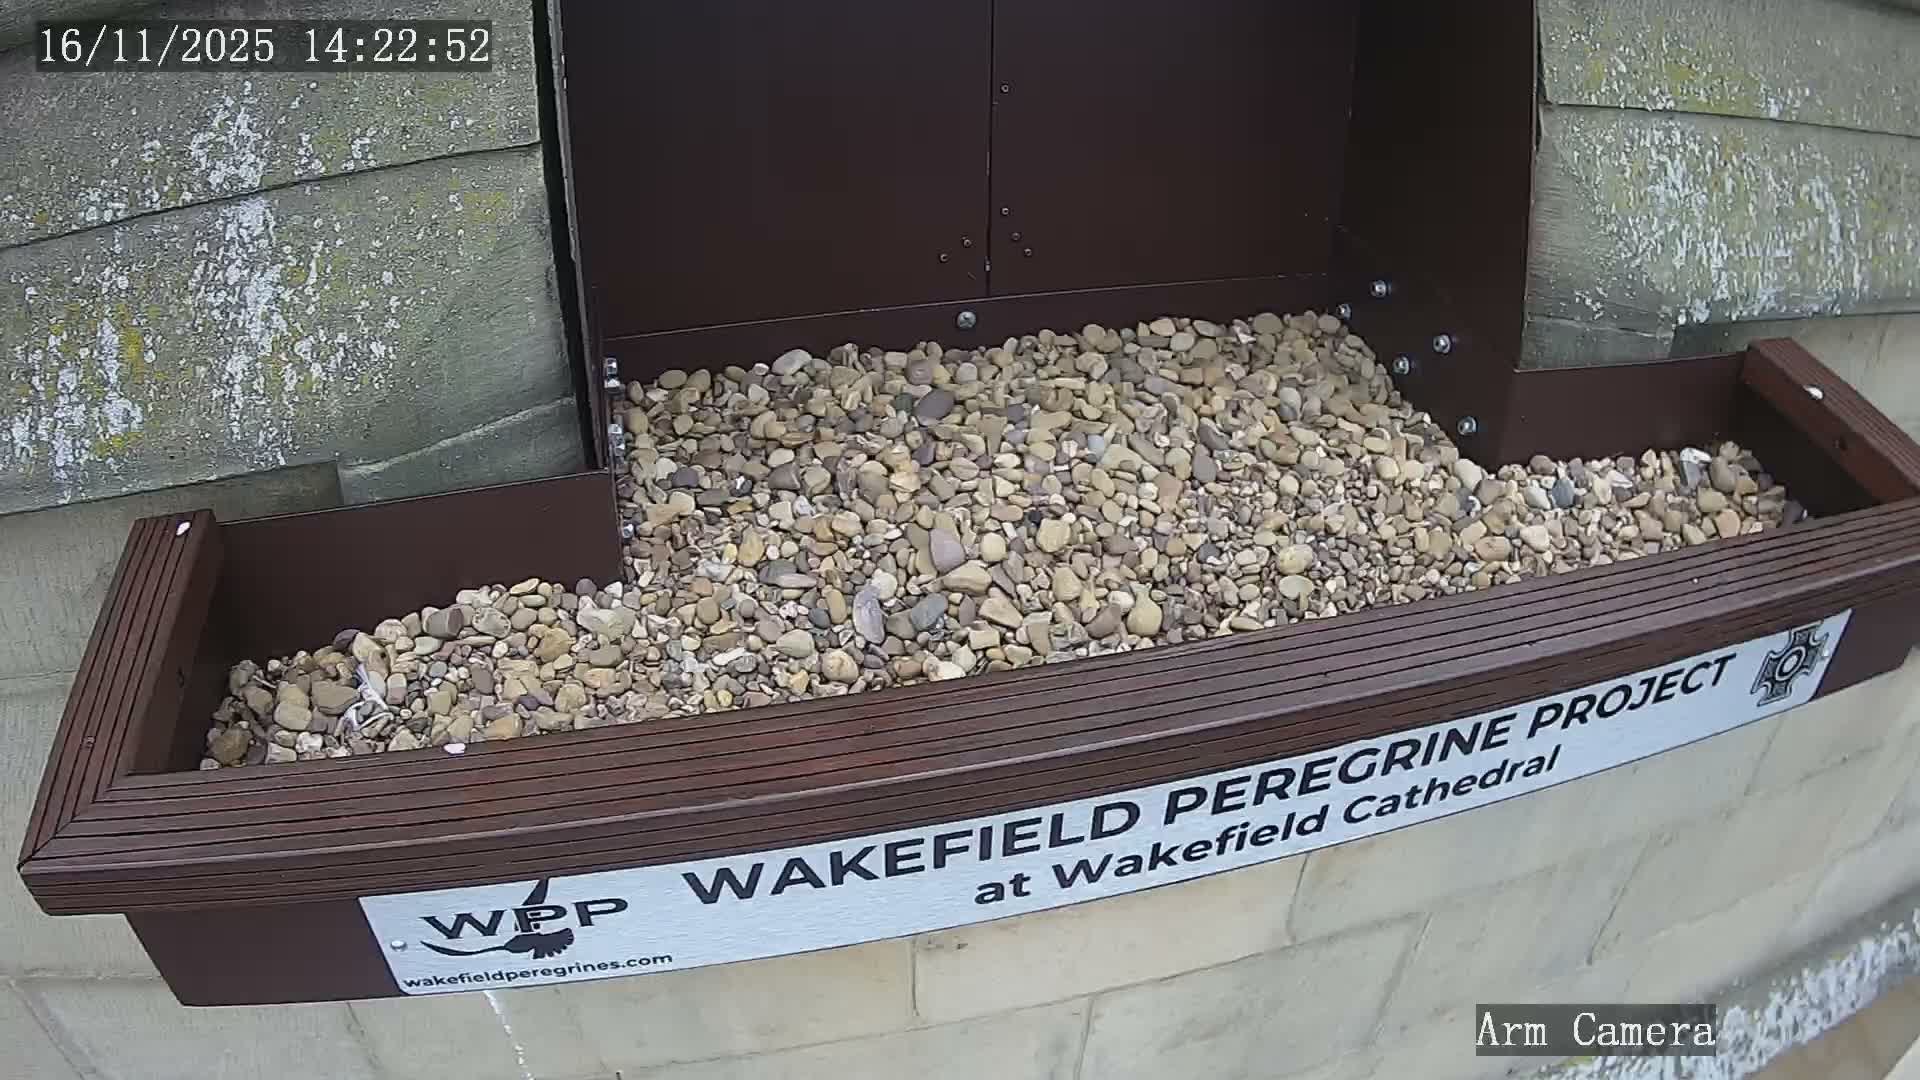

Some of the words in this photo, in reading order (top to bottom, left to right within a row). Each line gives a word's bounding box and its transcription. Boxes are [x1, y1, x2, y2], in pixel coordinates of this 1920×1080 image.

[682, 800, 1141, 905] WAKEFIELD
[1164, 713, 1518, 825] PEREGRINE
[1527, 652, 1737, 739] PROJECT
[974, 872, 1031, 905] at
[1052, 805, 1329, 890] Wakefield
[1342, 745, 1563, 824] Cathedral
[419, 897, 629, 940] WPP
[403, 952, 673, 989] wakefieldperegrines.com
